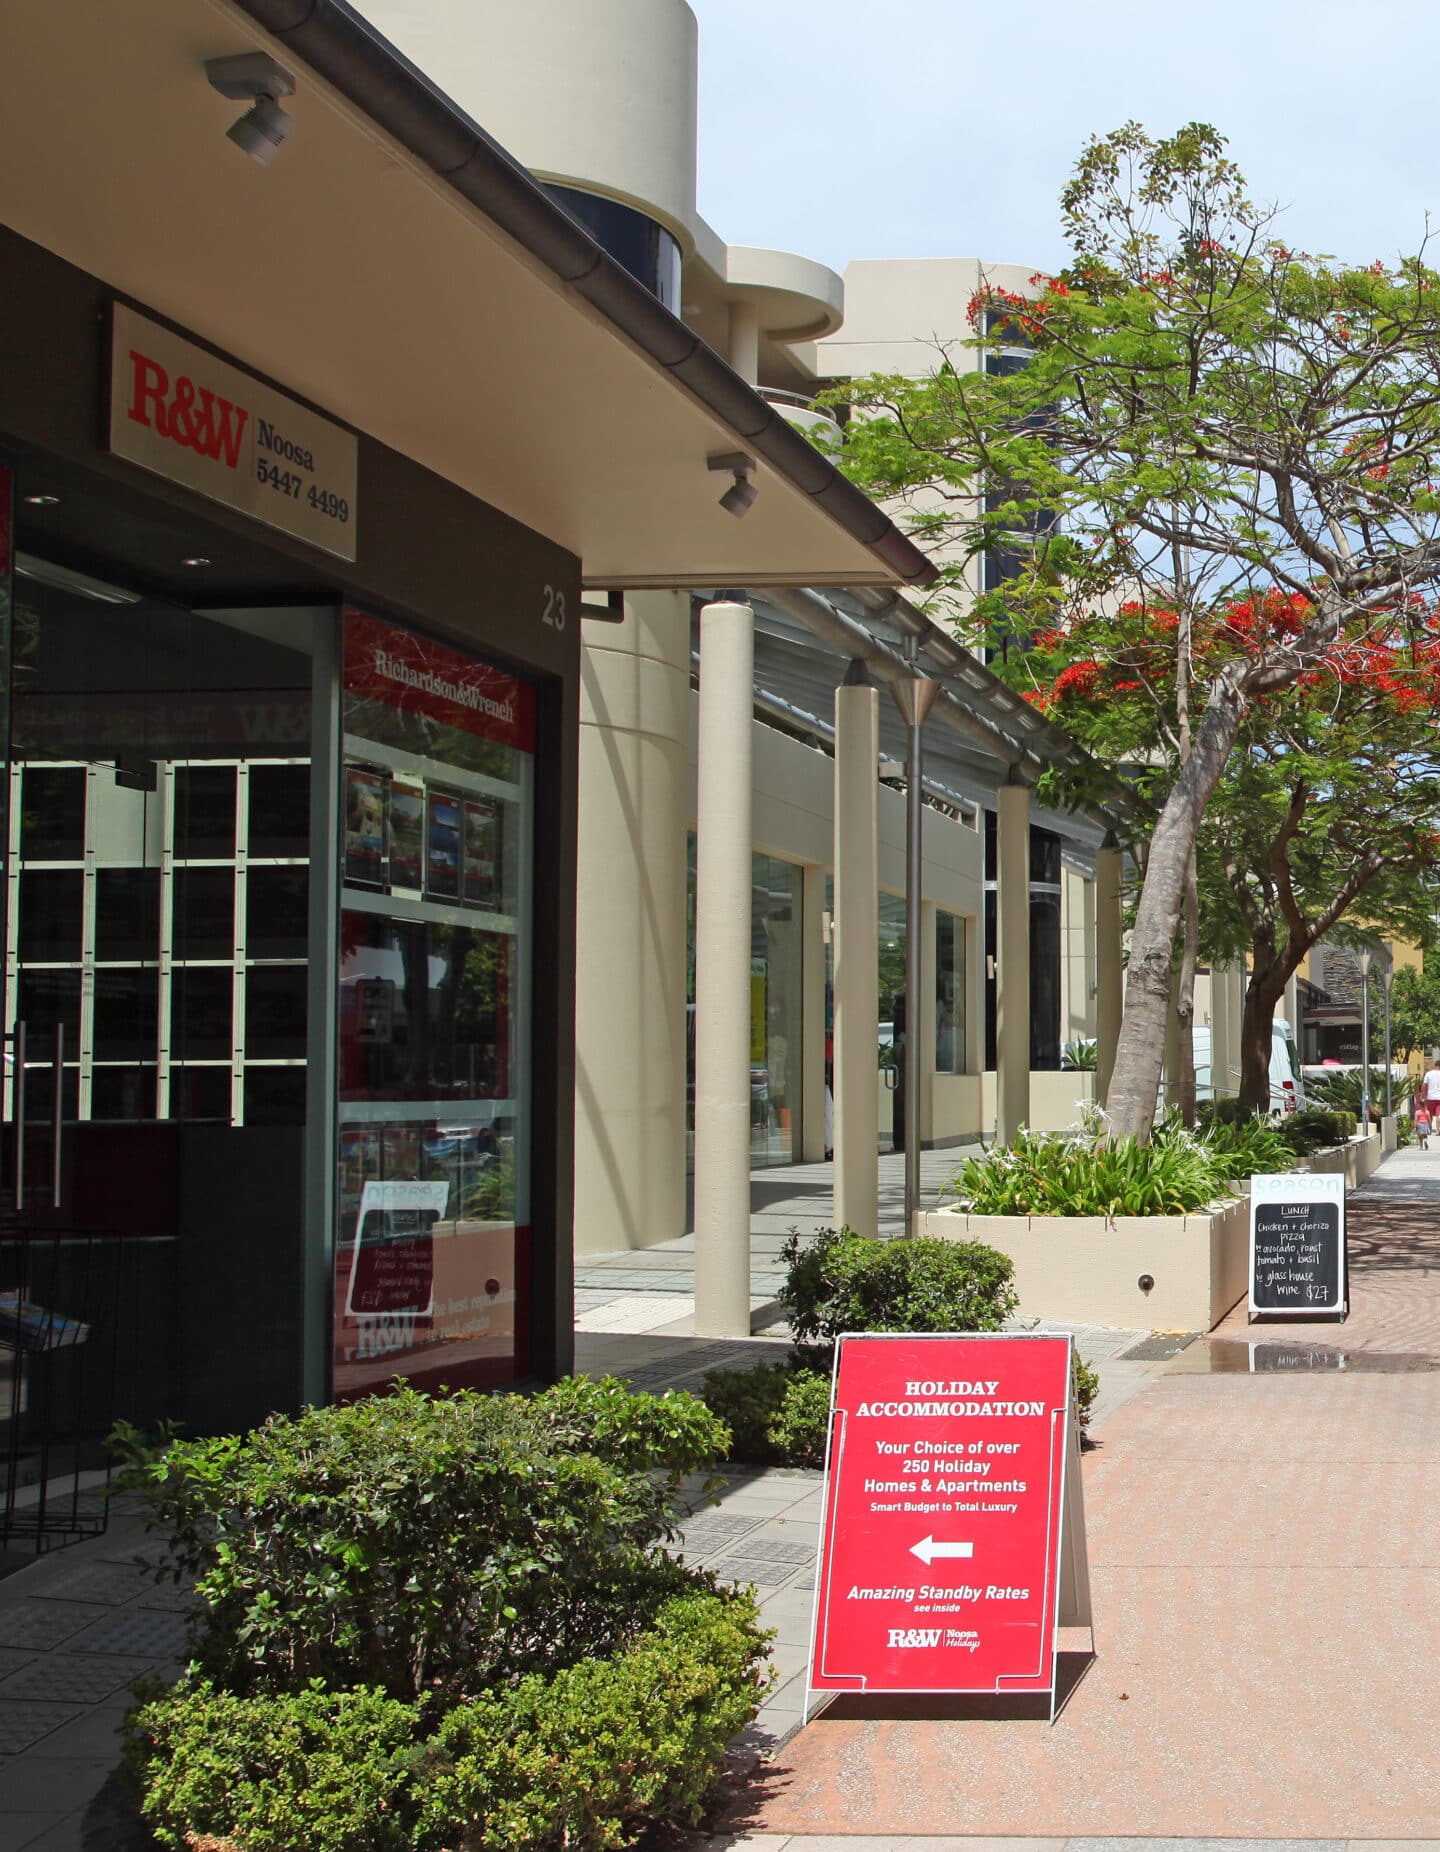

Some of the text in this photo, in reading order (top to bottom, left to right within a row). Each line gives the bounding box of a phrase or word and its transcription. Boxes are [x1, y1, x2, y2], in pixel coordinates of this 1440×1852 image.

[128, 349, 249, 469] R&W
[257, 418, 315, 473] Noosa
[256, 457, 349, 523] 5447 4499
[542, 584, 566, 632] 23
[374, 650, 514, 723] Richardson&Wrench
[1255, 1178, 1340, 1194] season
[1257, 1222, 1288, 1232] Chicken
[1280, 1233, 1305, 1245] pizza
[1265, 1271, 1287, 1286] glass
[1288, 1269, 1314, 1282] house
[1306, 1285, 1329, 1301] $27
[905, 1381, 999, 1396] HOLIDAY
[855, 1402, 1045, 1417] ACCOMMODATION
[876, 1441, 1020, 1455] Your Choice of over
[903, 1460, 990, 1476] 250 Holiday
[864, 1479, 1027, 1495] Homes & Apartments
[870, 1502, 1017, 1514] Smart Budget to Total Luxury
[847, 1585, 1029, 1602] Amazing Standby Rates
[914, 1603, 960, 1613] see inside
[887, 1629, 943, 1648] R&W
[947, 1629, 978, 1638] Noosa
